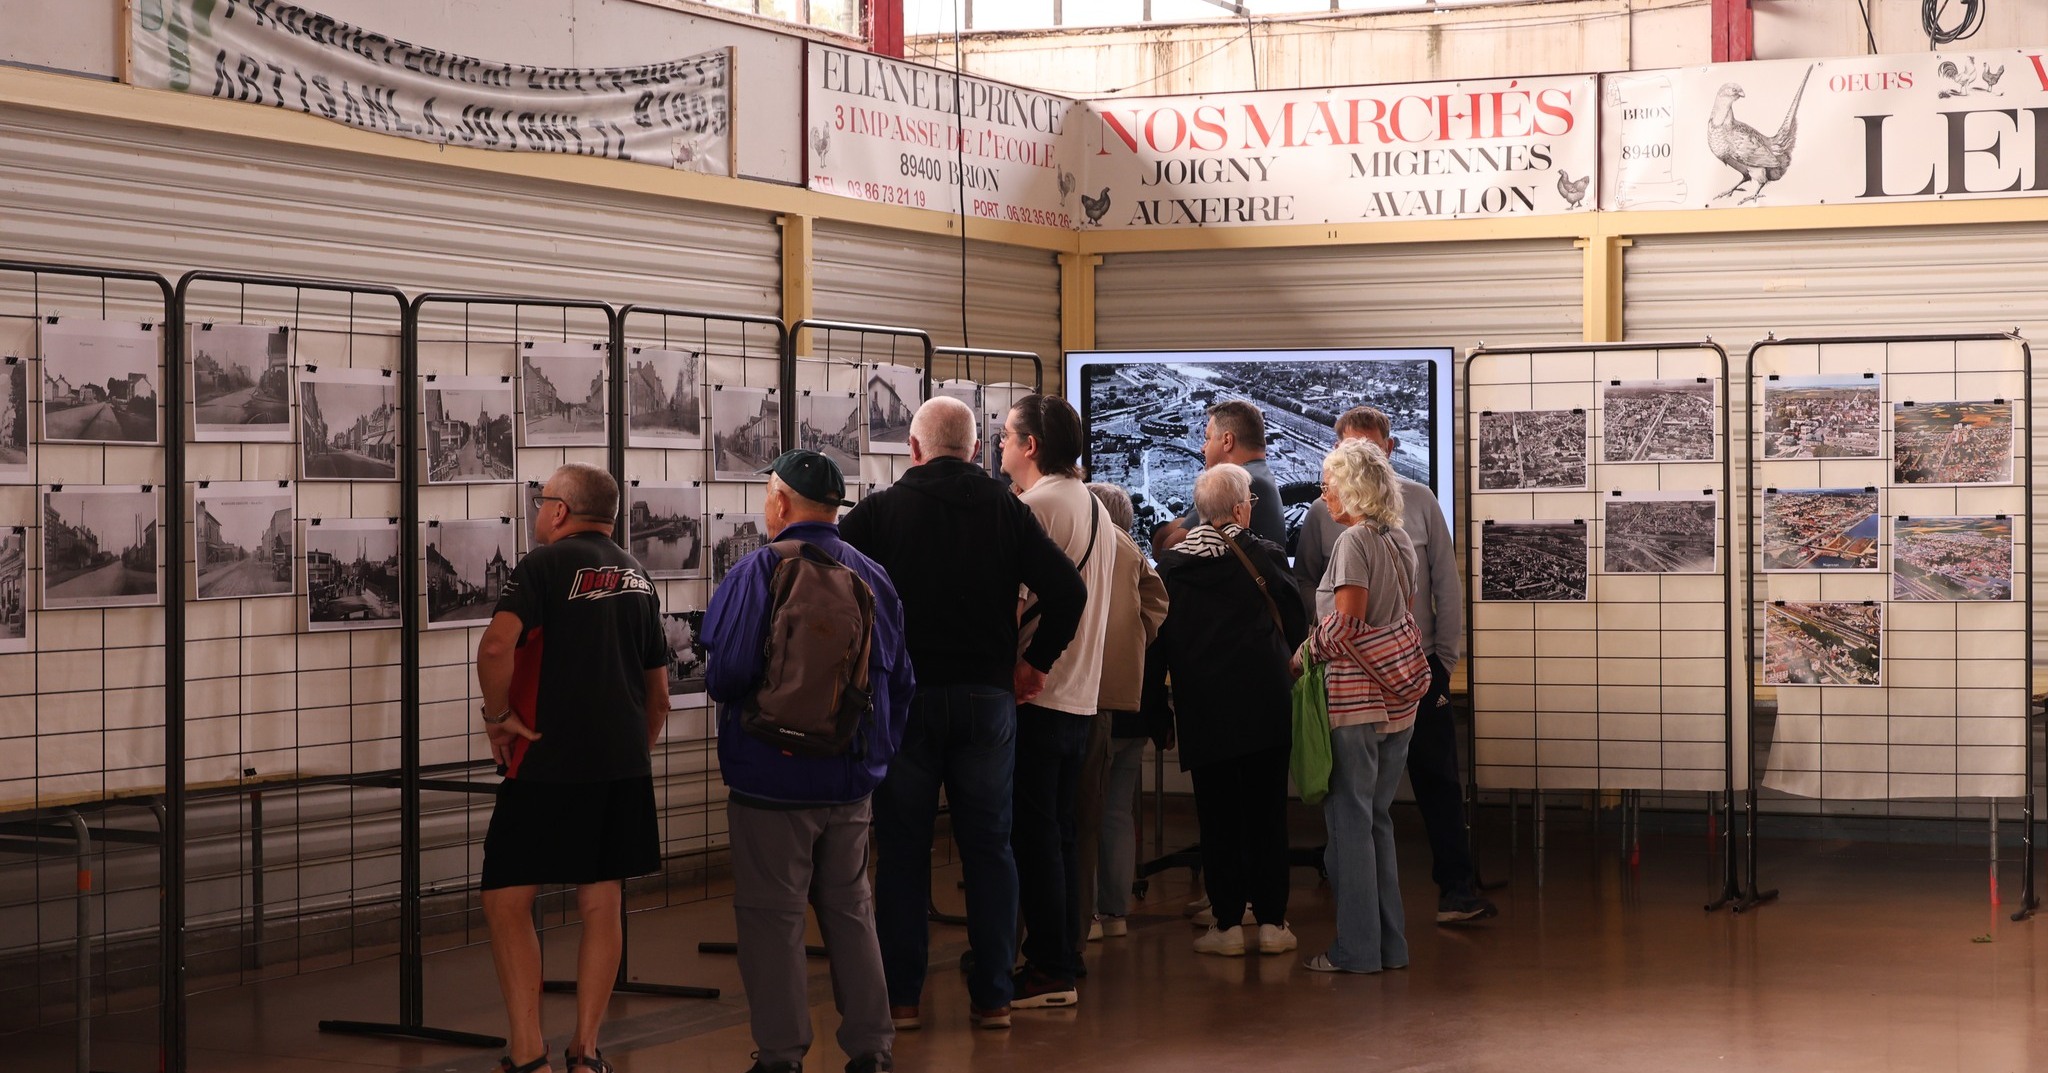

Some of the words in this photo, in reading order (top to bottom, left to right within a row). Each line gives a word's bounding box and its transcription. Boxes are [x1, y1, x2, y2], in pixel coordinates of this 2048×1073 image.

[823, 50, 931, 110] ELIANE
[934, 72, 1064, 136] LEPRINCE
[1829, 71, 1914, 92] OEUFS
[835, 105, 845, 131] 3
[850, 107, 941, 149] IMPASSE
[947, 125, 972, 155] DE
[1096, 105, 1229, 155] NOS
[1242, 80, 1575, 149] MARCHÉS
[1622, 106, 1672, 121] BRION
[900, 152, 942, 182] 89400
[949, 161, 1000, 192] BRION
[1141, 156, 1279, 187] JOIGNY
[1350, 144, 1552, 179] MIGENNES
[1622, 143, 1672, 161] 89400
[847, 180, 863, 198] 03
[864, 182, 879, 200] 86
[882, 185, 894, 203] 73
[896, 187, 910, 204] 21
[914, 190, 926, 207] 19
[1126, 195, 1295, 226] AUXERRE
[1363, 185, 1538, 218] AVALLON
[974, 199, 999, 218] PORT
[1020, 207, 1033, 223] 32
[1033, 209, 1046, 225] 35
[1046, 211, 1059, 227] 62
[1059, 213, 1071, 229] 26
